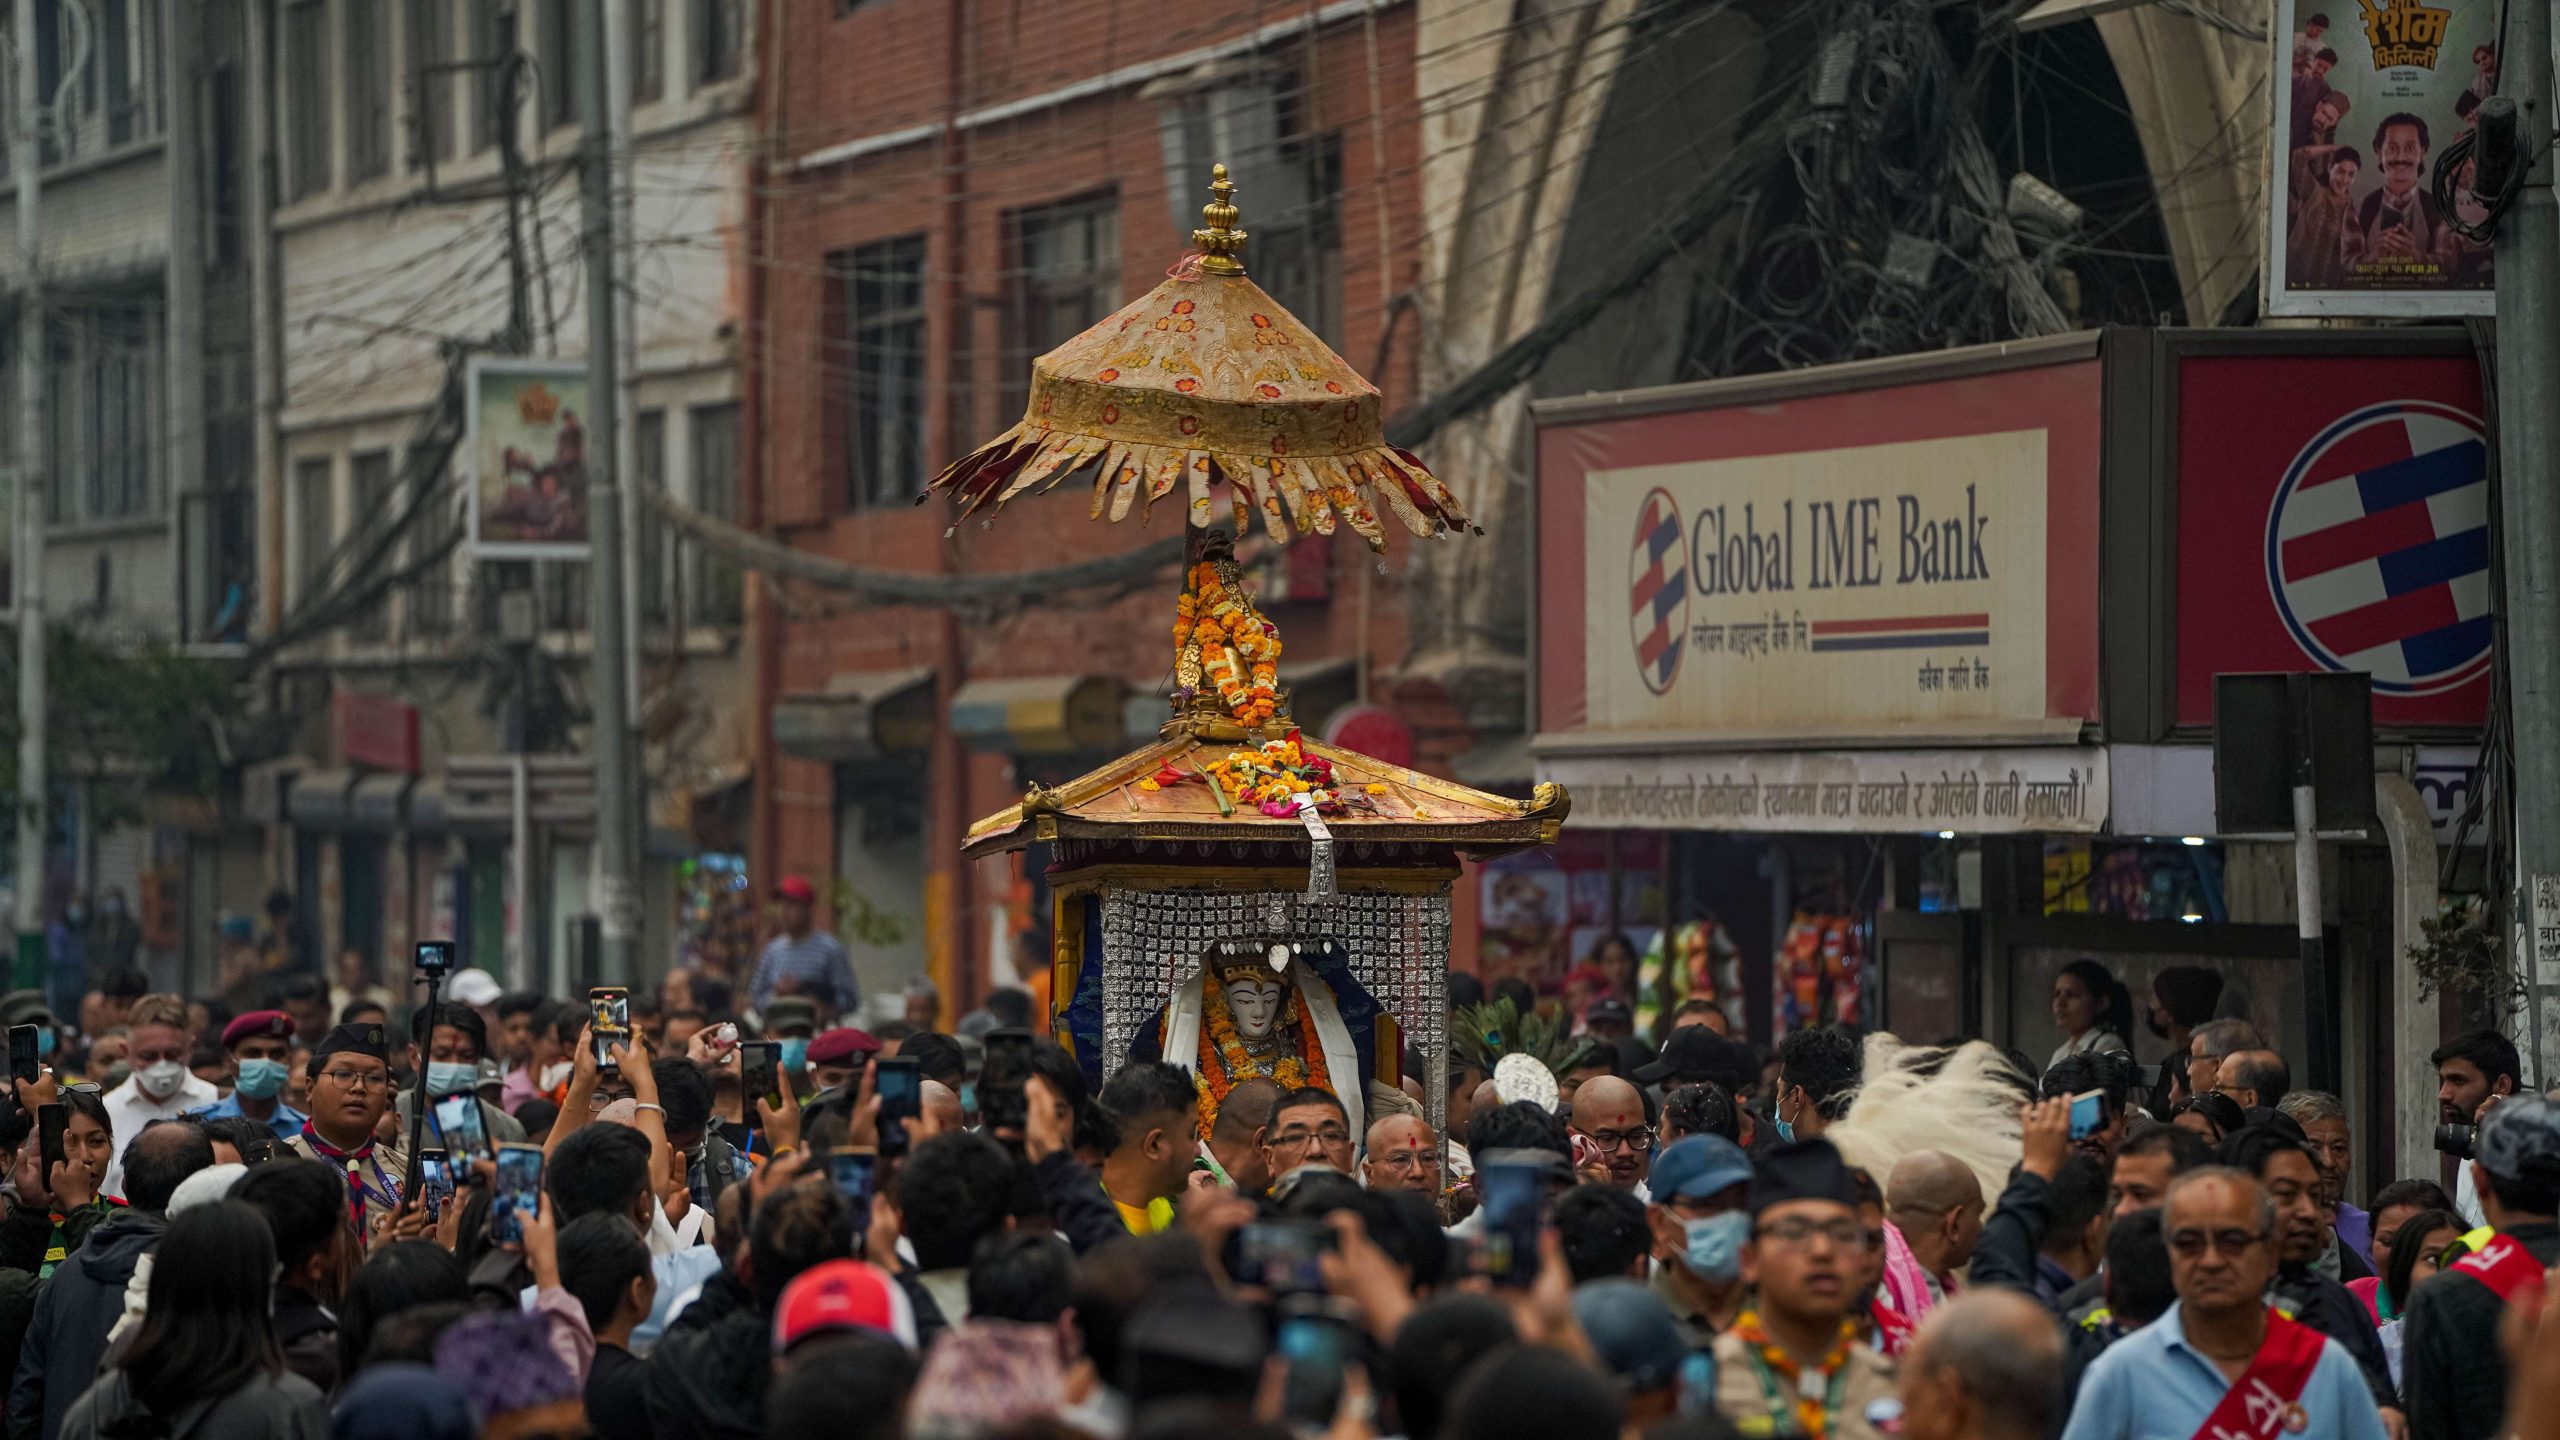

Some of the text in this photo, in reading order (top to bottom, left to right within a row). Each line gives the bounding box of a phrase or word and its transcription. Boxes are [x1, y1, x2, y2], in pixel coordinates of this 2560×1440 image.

[2374, 44, 2436, 70] फिलिली
[2405, 264, 2425, 273] FEB
[2426, 264, 2439, 273] 26
[1692, 483, 1990, 596] Global IME Bank
[1948, 656, 1969, 692] लागि
[1821, 783, 1853, 818] मात्र
[1914, 783, 1927, 818] र
[1983, 769, 2021, 818] बानी
